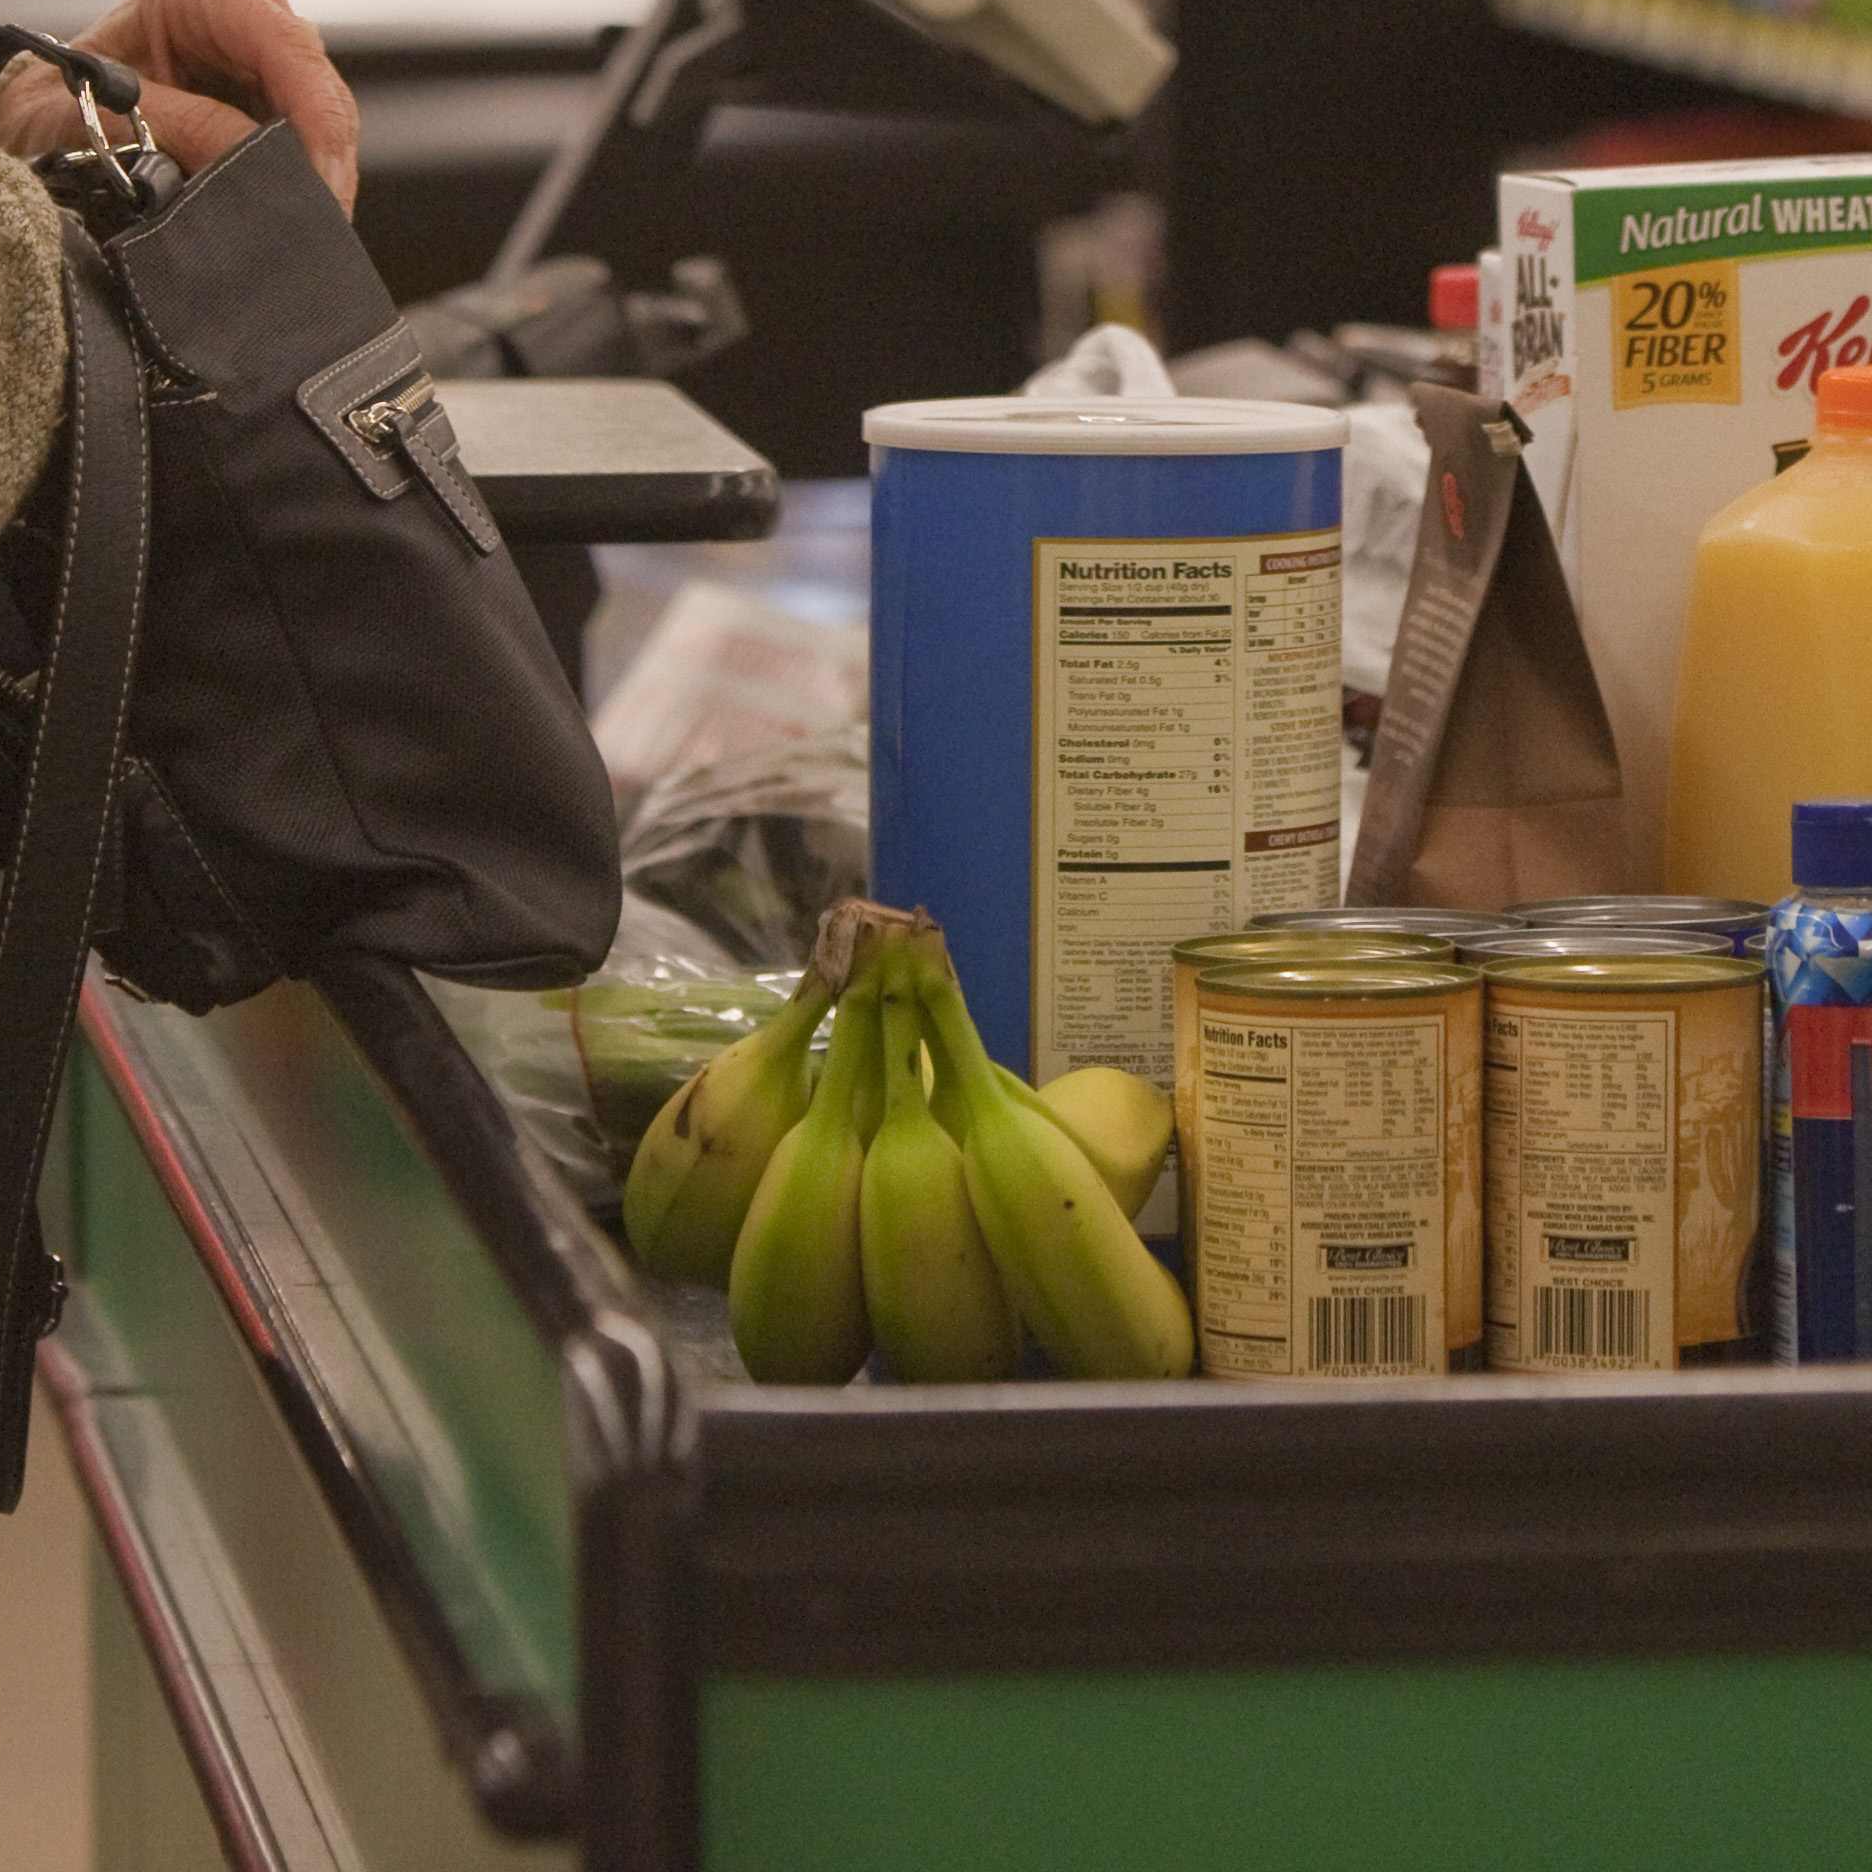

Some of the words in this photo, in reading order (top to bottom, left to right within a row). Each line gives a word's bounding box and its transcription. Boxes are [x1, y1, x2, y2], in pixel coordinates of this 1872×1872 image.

[1620, 192, 1764, 256] Natural
[1624, 279, 1727, 331] 20%
[1512, 311, 1566, 383] BRAN
[1624, 332, 1727, 369] FIBER
[1640, 372, 1656, 395] 5
[1658, 371, 1713, 388] GRAMS
[1059, 561, 1166, 580] Nutrition
[1173, 560, 1232, 578] Facts
[1059, 630, 1108, 640] Calories
[1060, 659, 1090, 670] Total
[1093, 659, 1114, 670] Fat
[1068, 675, 1121, 686] Saturated
[1123, 675, 1137, 686] Fat
[1068, 691, 1096, 702] Trans
[1098, 691, 1114, 702] Fat
[1068, 707, 1150, 718] Polyunsaturated
[1152, 707, 1170, 718] Fat
[1058, 738, 1129, 749] Cholesterol
[1058, 753, 1104, 764] Sodium
[1058, 769, 1089, 782] Total
[1092, 769, 1177, 782] Carbohydrate
[1068, 786, 1104, 797] Dietary
[1107, 786, 1133, 797] Fiber
[1067, 833, 1104, 845] Sugars
[1058, 849, 1103, 860] Protein
[1058, 891, 1097, 902] Vitamin
[1099, 891, 1108, 902] C
[1058, 907, 1100, 917] Calcium
[1203, 1024, 1244, 1046] Nutrition
[1247, 1030, 1289, 1049] Facts
[1069, 1055, 1146, 1064] INGREDIENTS:
[1552, 1277, 1579, 1287] BEST
[1582, 1278, 1624, 1288] CHOICE
[1331, 1285, 1360, 1296] BEST
[1364, 1285, 1405, 1296] CHOICE
